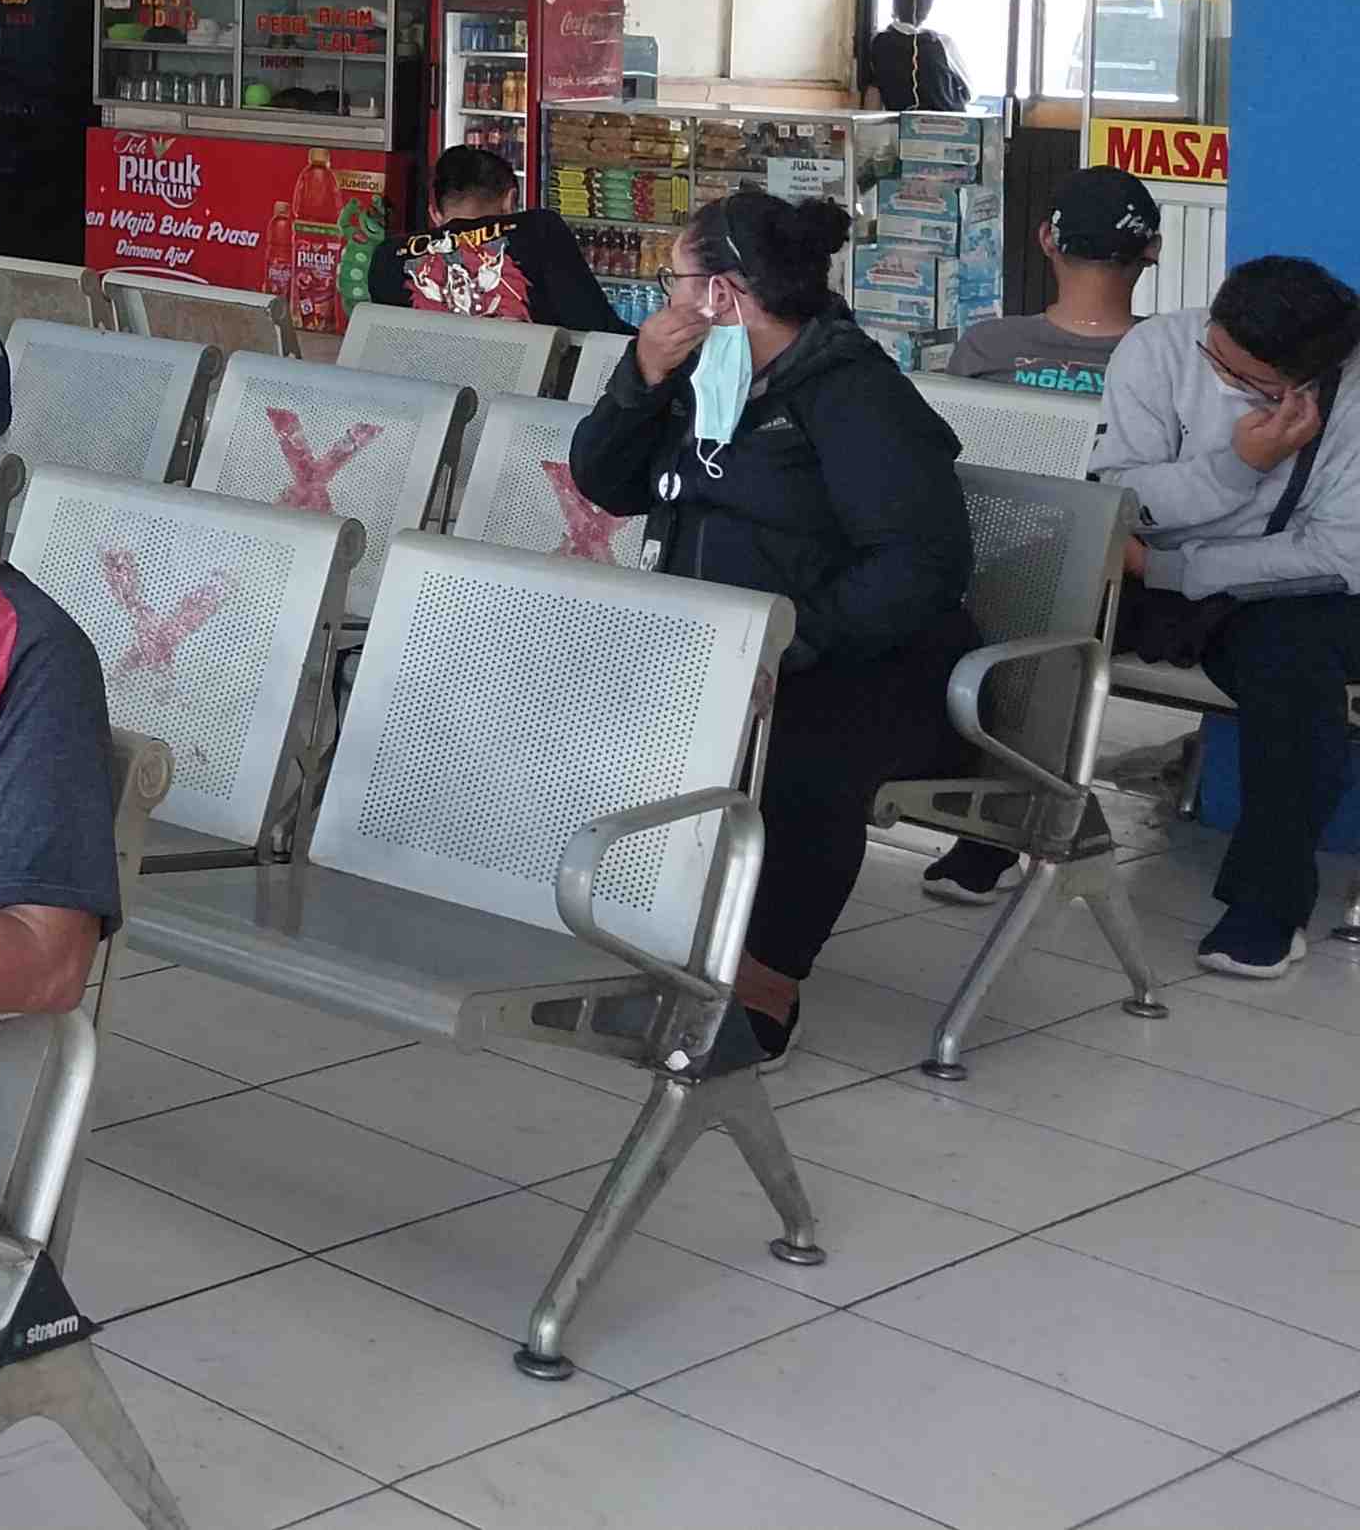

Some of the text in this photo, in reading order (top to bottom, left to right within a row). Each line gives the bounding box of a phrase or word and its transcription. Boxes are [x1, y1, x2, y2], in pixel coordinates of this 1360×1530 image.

[1106, 126, 1229, 180] MASA
[118, 154, 202, 192] pucuk
[132, 178, 194, 201] HARUM
[109, 208, 157, 238] Wajib
[159, 214, 204, 241] Buka
[207, 220, 261, 248] Puasa
[115, 238, 162, 261] Dimana
